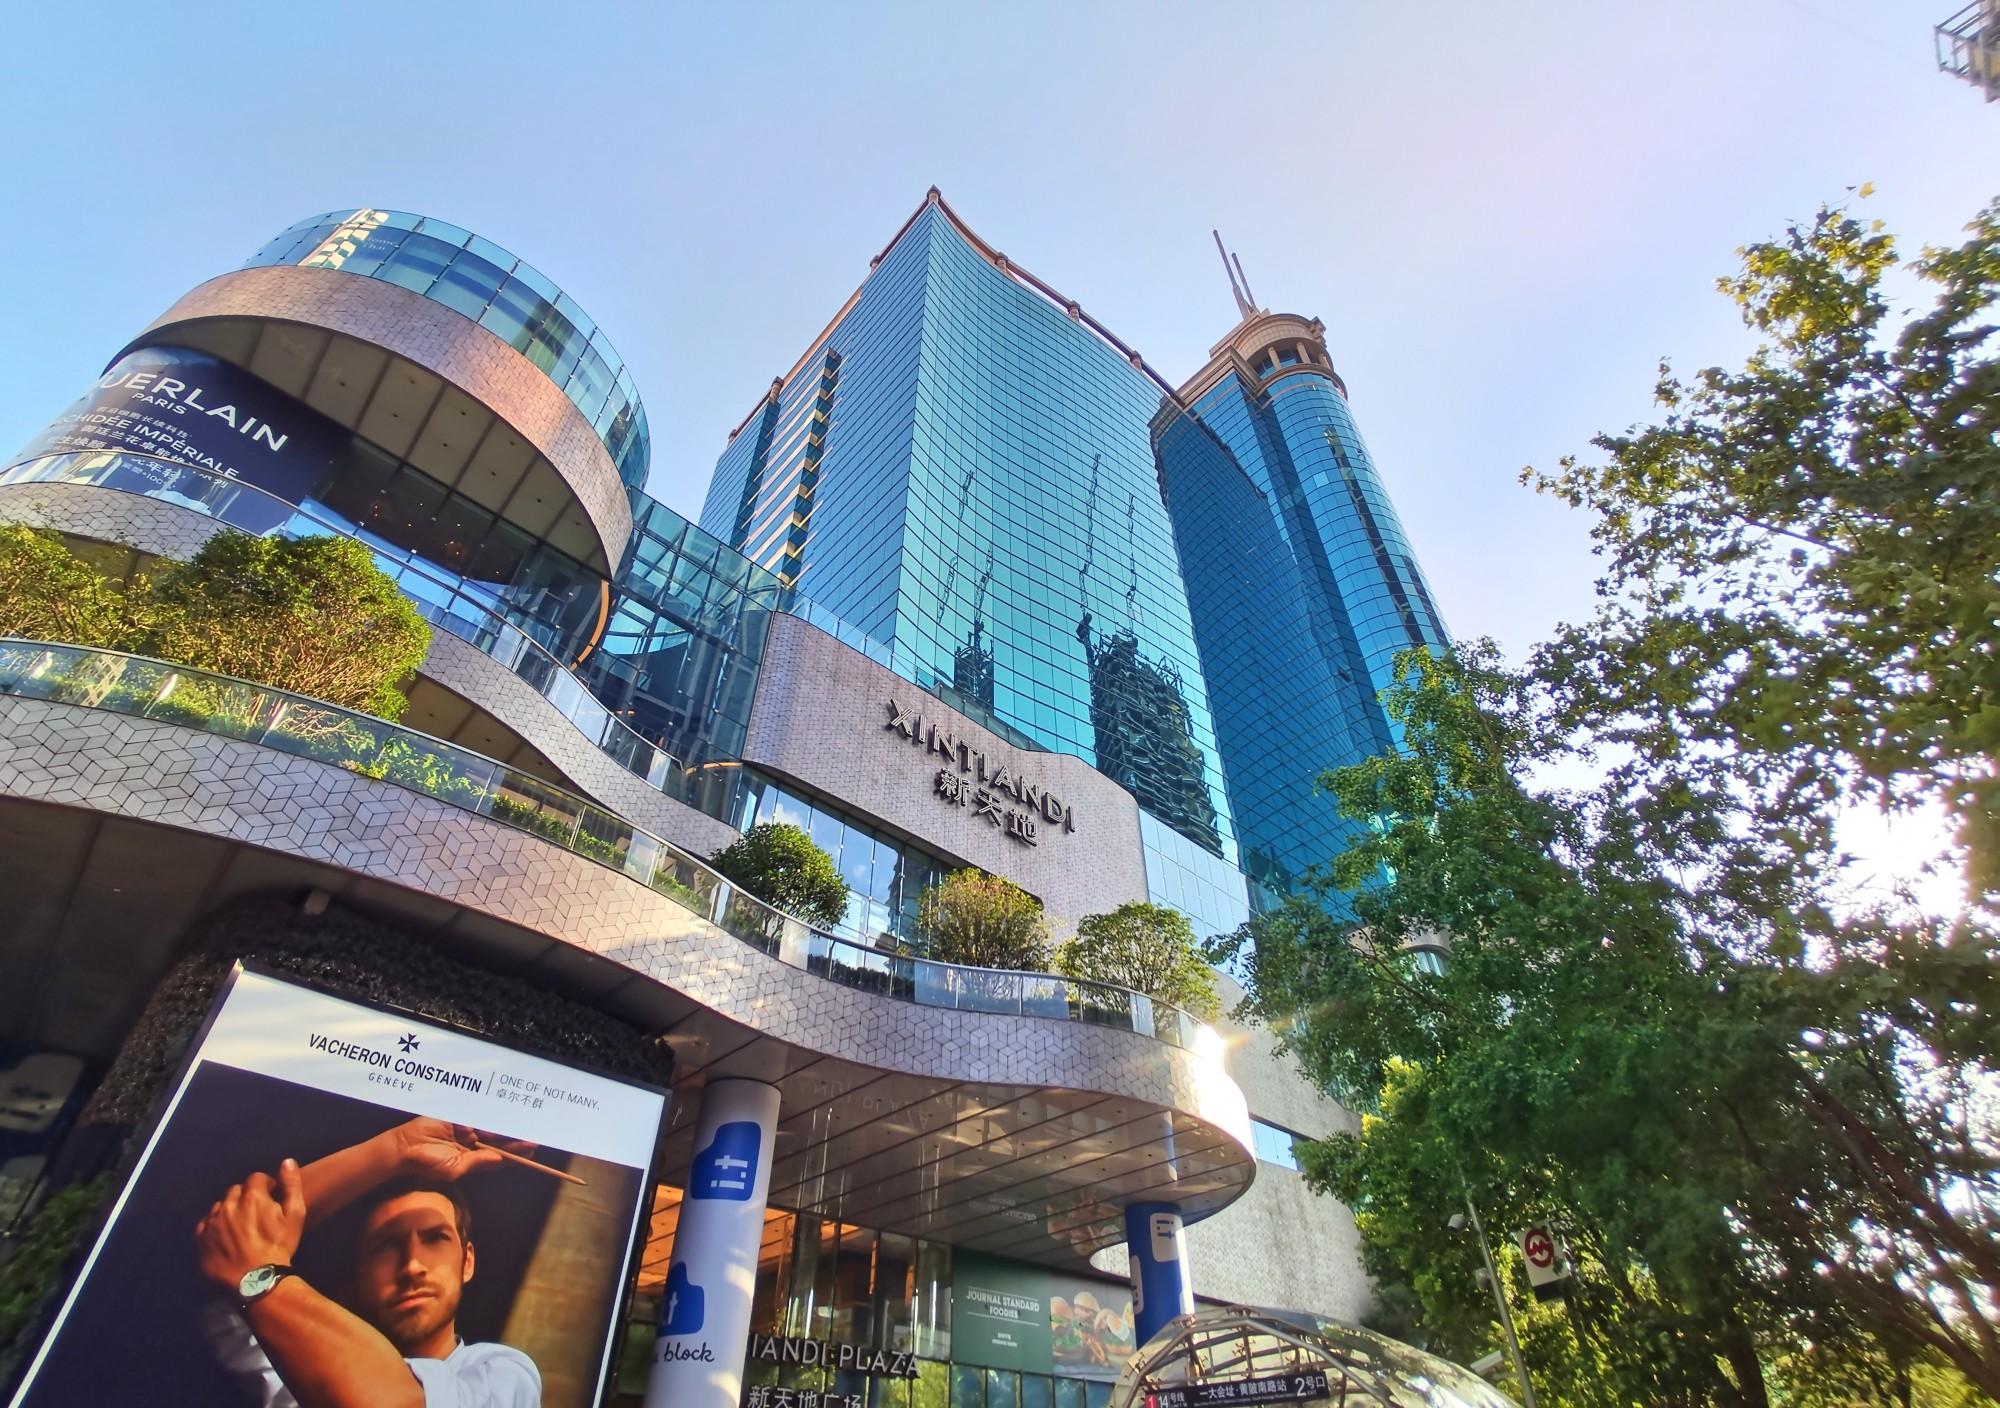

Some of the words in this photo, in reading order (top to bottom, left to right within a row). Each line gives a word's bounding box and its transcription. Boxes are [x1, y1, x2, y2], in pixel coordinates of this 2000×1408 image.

[132, 393, 187, 415] PARIS
[133, 424, 239, 479] IMPÉRIALE
[890, 698, 1075, 833] XINTIANDI
[939, 767, 1037, 848] 新天地
[309, 1033, 391, 1069] VACHERON
[394, 1058, 482, 1093] CONSTANTIN
[500, 1073, 525, 1088] ONE
[525, 1080, 541, 1092] OF
[543, 1085, 566, 1100] NOT
[567, 1092, 600, 1110] MANY.
[966, 1289, 1002, 1306] JOURNAL
[1002, 1296, 1040, 1313] STANDARD
[989, 1305, 1019, 1320] FOODIES
[664, 1341, 715, 1363] block
[839, 1344, 921, 1376] PLAZA
[747, 1385, 862, 1408] 新天地广场
